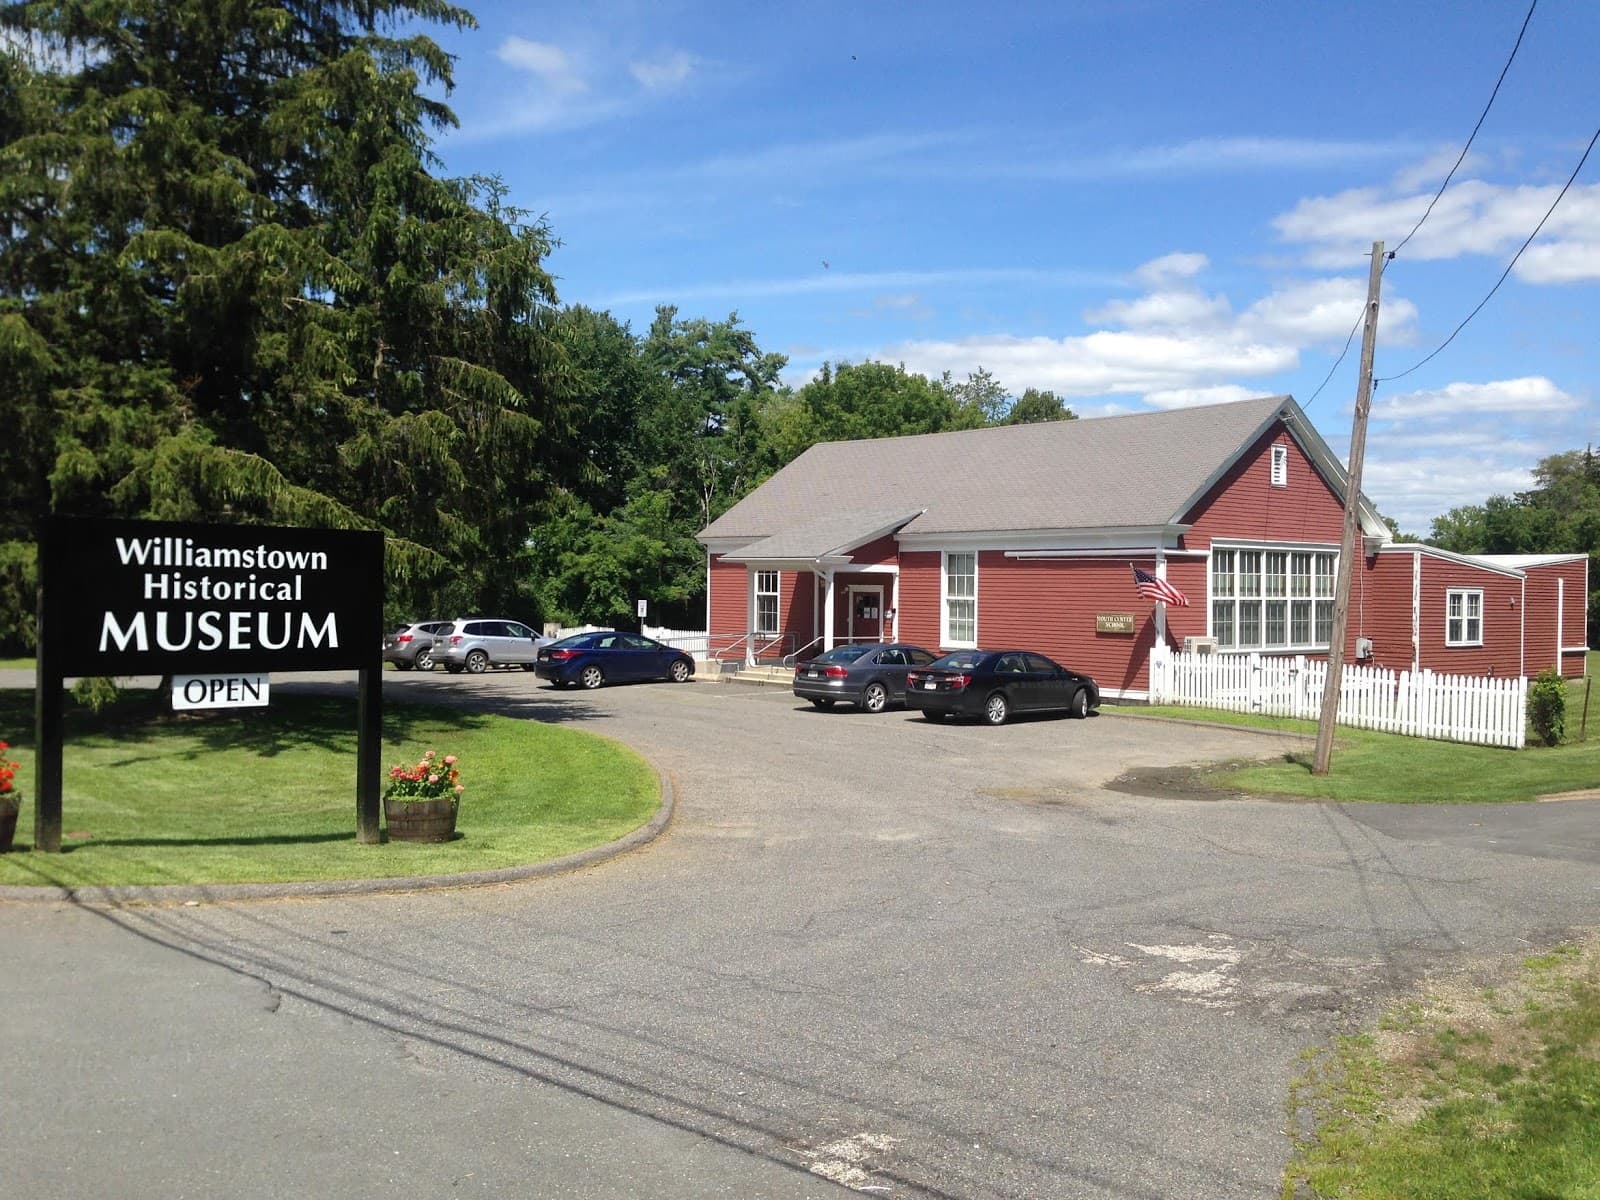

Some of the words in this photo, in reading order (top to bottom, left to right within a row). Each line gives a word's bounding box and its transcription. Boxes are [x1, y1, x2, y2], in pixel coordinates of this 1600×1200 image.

[115, 536, 328, 570] Williamstown
[144, 571, 302, 601] Historical
[98, 610, 339, 652] MUSEUM
[183, 676, 261, 704] OPEN
